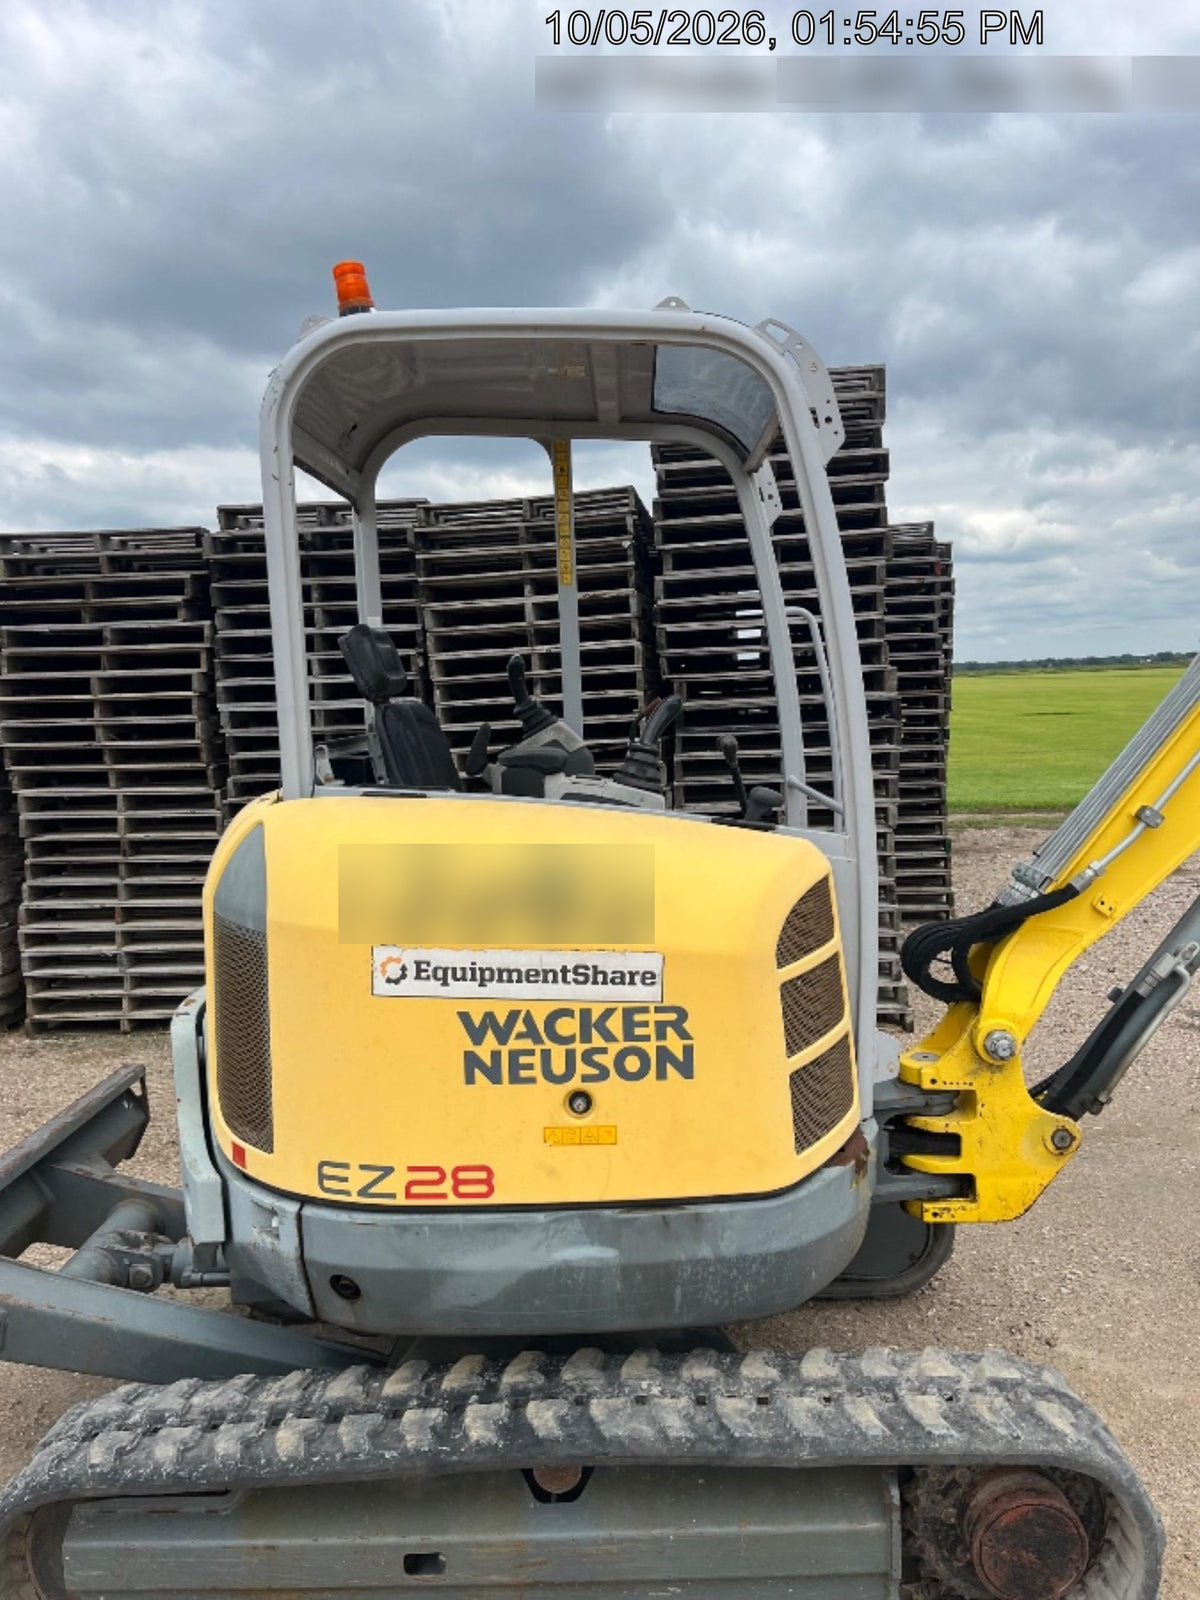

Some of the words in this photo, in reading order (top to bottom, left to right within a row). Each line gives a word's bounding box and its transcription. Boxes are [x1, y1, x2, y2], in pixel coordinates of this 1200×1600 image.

[413, 959, 657, 987] EquipmentShare
[456, 1005, 694, 1046] WACKER
[463, 1044, 694, 1085] NEUSON
[317, 1160, 495, 1200] EZ28
